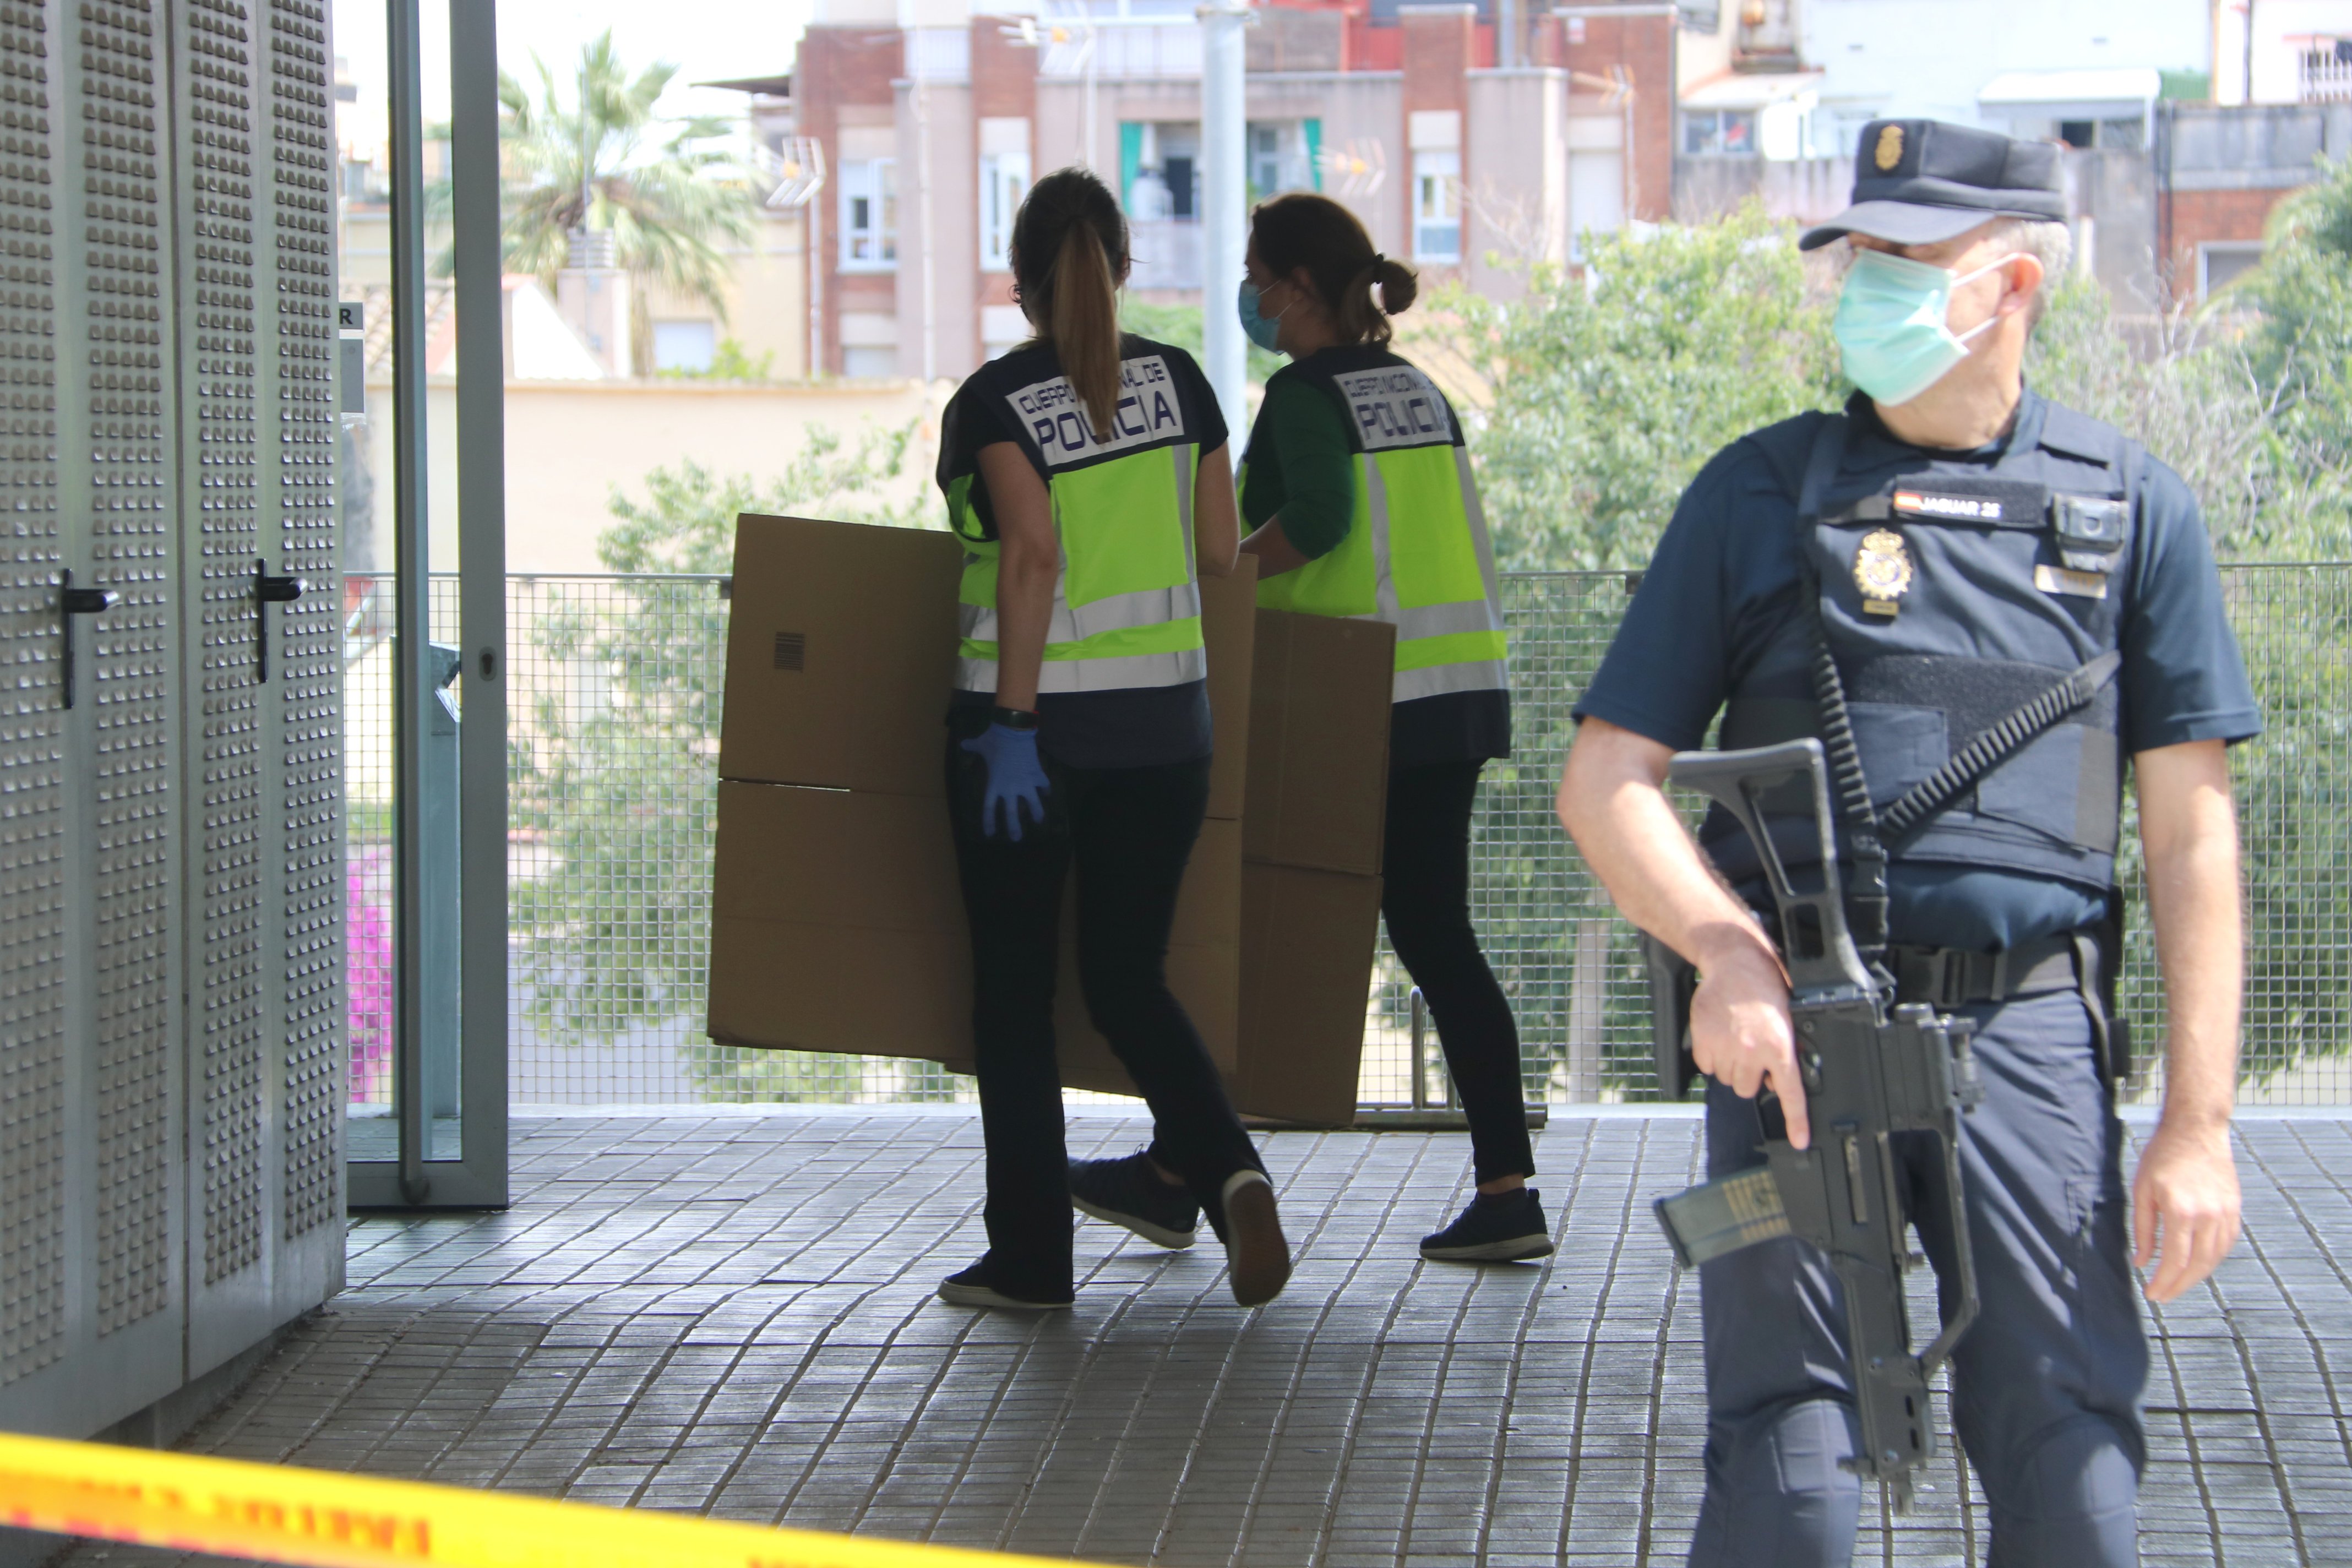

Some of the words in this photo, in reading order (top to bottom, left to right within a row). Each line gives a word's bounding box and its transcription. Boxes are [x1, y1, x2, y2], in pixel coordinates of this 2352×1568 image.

[1019, 384, 1076, 415] CUERPO
[1142, 362, 1166, 383] DE
[1032, 390, 1177, 451] POLICIA
